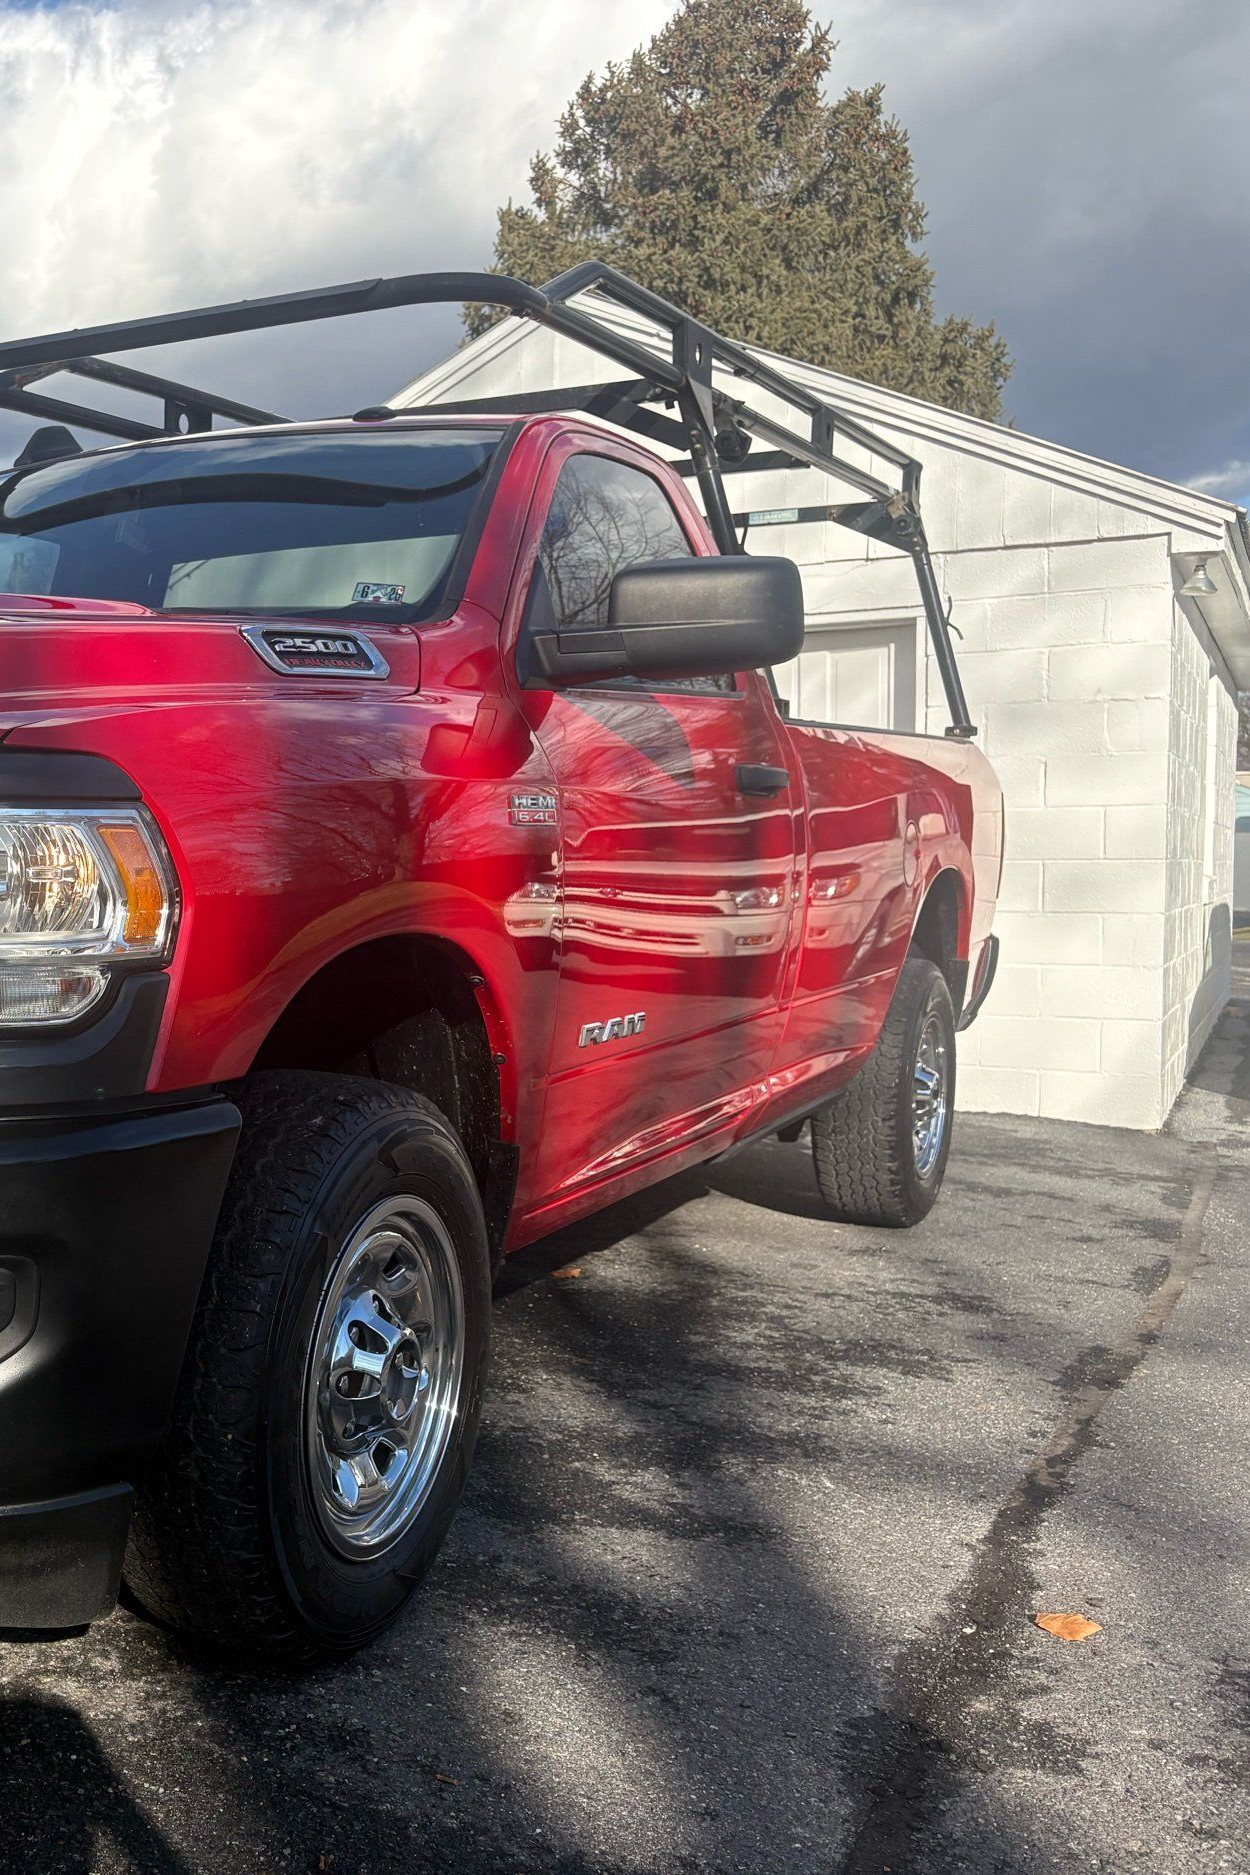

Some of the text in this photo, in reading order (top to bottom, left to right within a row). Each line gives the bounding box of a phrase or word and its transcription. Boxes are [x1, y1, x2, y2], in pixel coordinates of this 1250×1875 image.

[361, 585, 370, 599] 6
[272, 638, 357, 655] 2500
[284, 658, 366, 669] HEAVY DUTY
[513, 794, 556, 810] HEMI
[518, 811, 555, 823] 6.4L
[579, 1011, 646, 1047] RAM
